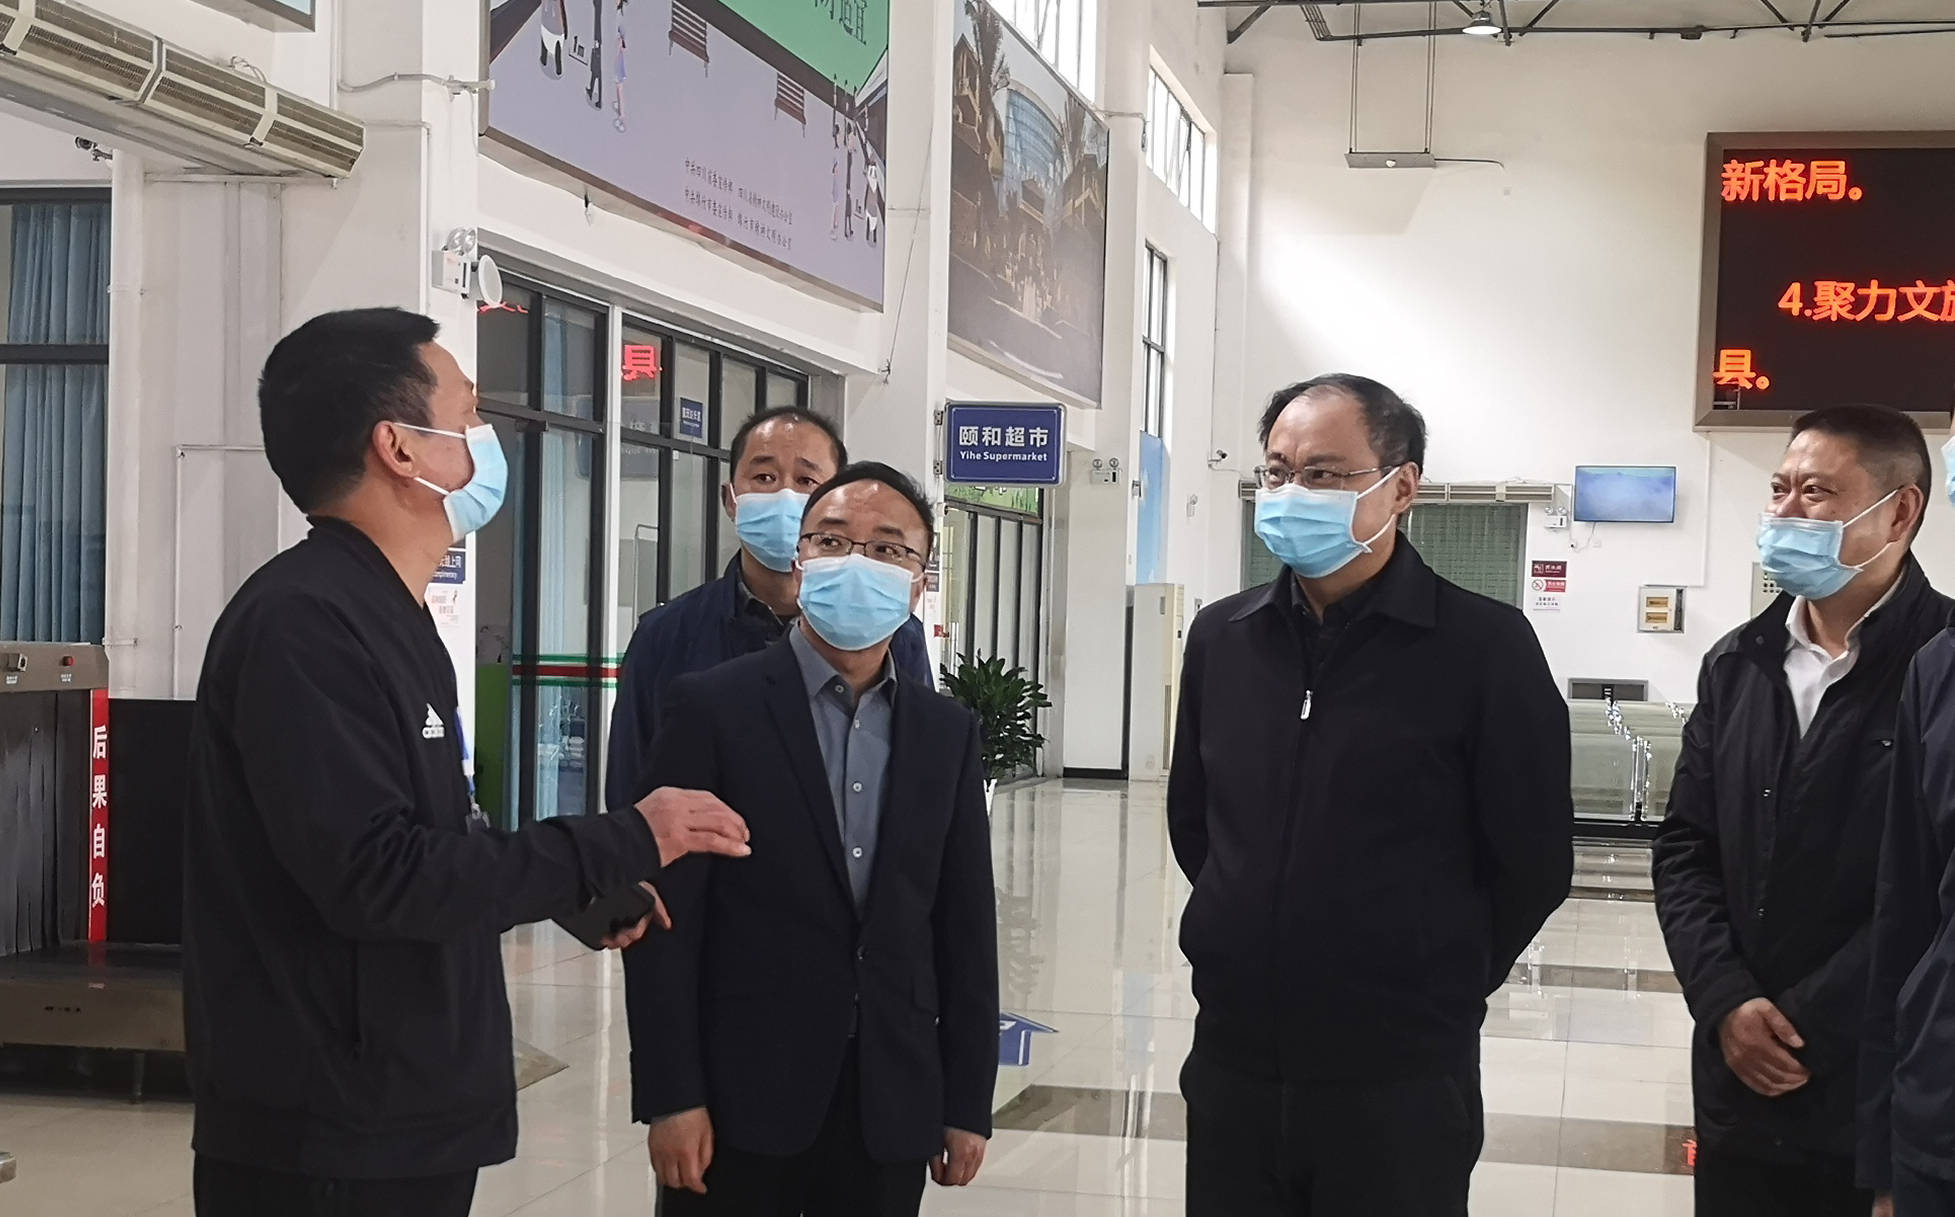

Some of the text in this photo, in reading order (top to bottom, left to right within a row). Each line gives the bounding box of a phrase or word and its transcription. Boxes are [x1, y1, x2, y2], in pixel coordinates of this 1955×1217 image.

[1721, 159, 1863, 201] 新格局。
[1713, 349, 1770, 390] 具。
[959, 426, 1049, 448] 颐和超市
[960, 451, 1048, 462] Yihe Supermarket
[91, 725, 108, 908] 后果自负
